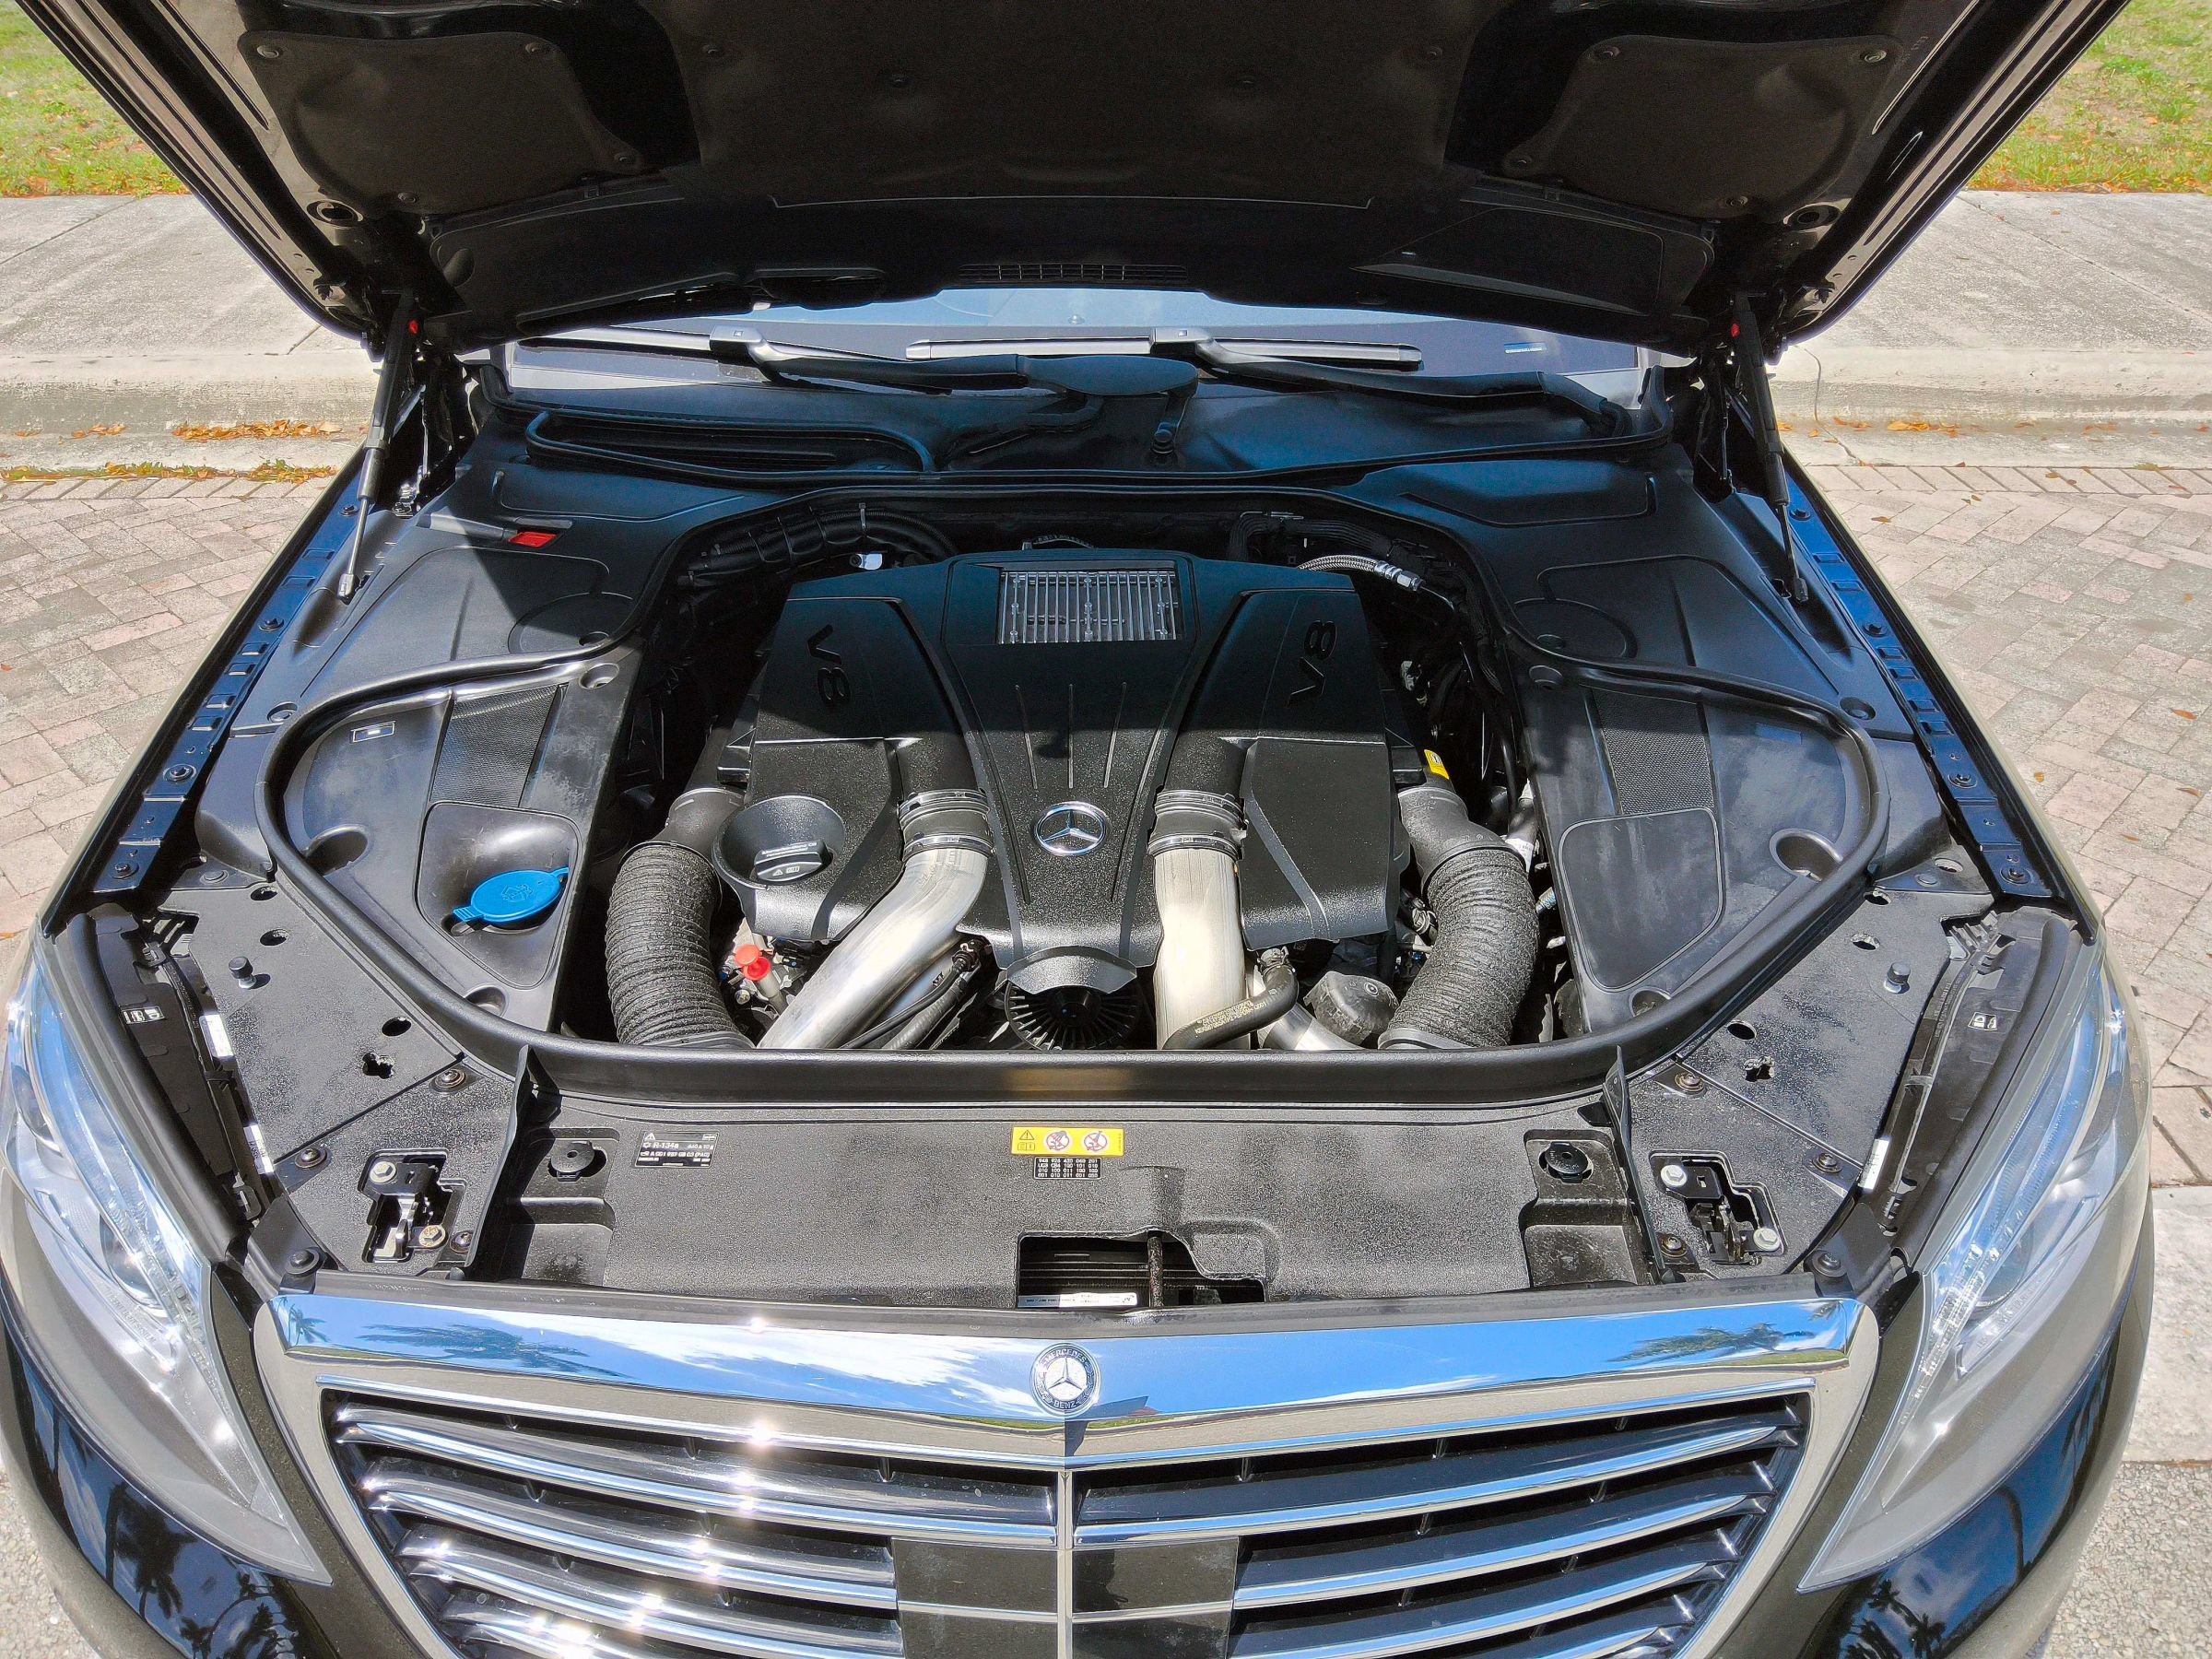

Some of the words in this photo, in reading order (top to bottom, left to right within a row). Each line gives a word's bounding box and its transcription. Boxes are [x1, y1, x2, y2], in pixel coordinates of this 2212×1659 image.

[806, 624, 851, 708] V8
[1285, 619, 1337, 707] V8
[1044, 1348, 1087, 1363] MERCEDES
[1053, 1400, 1077, 1409] BENZ
